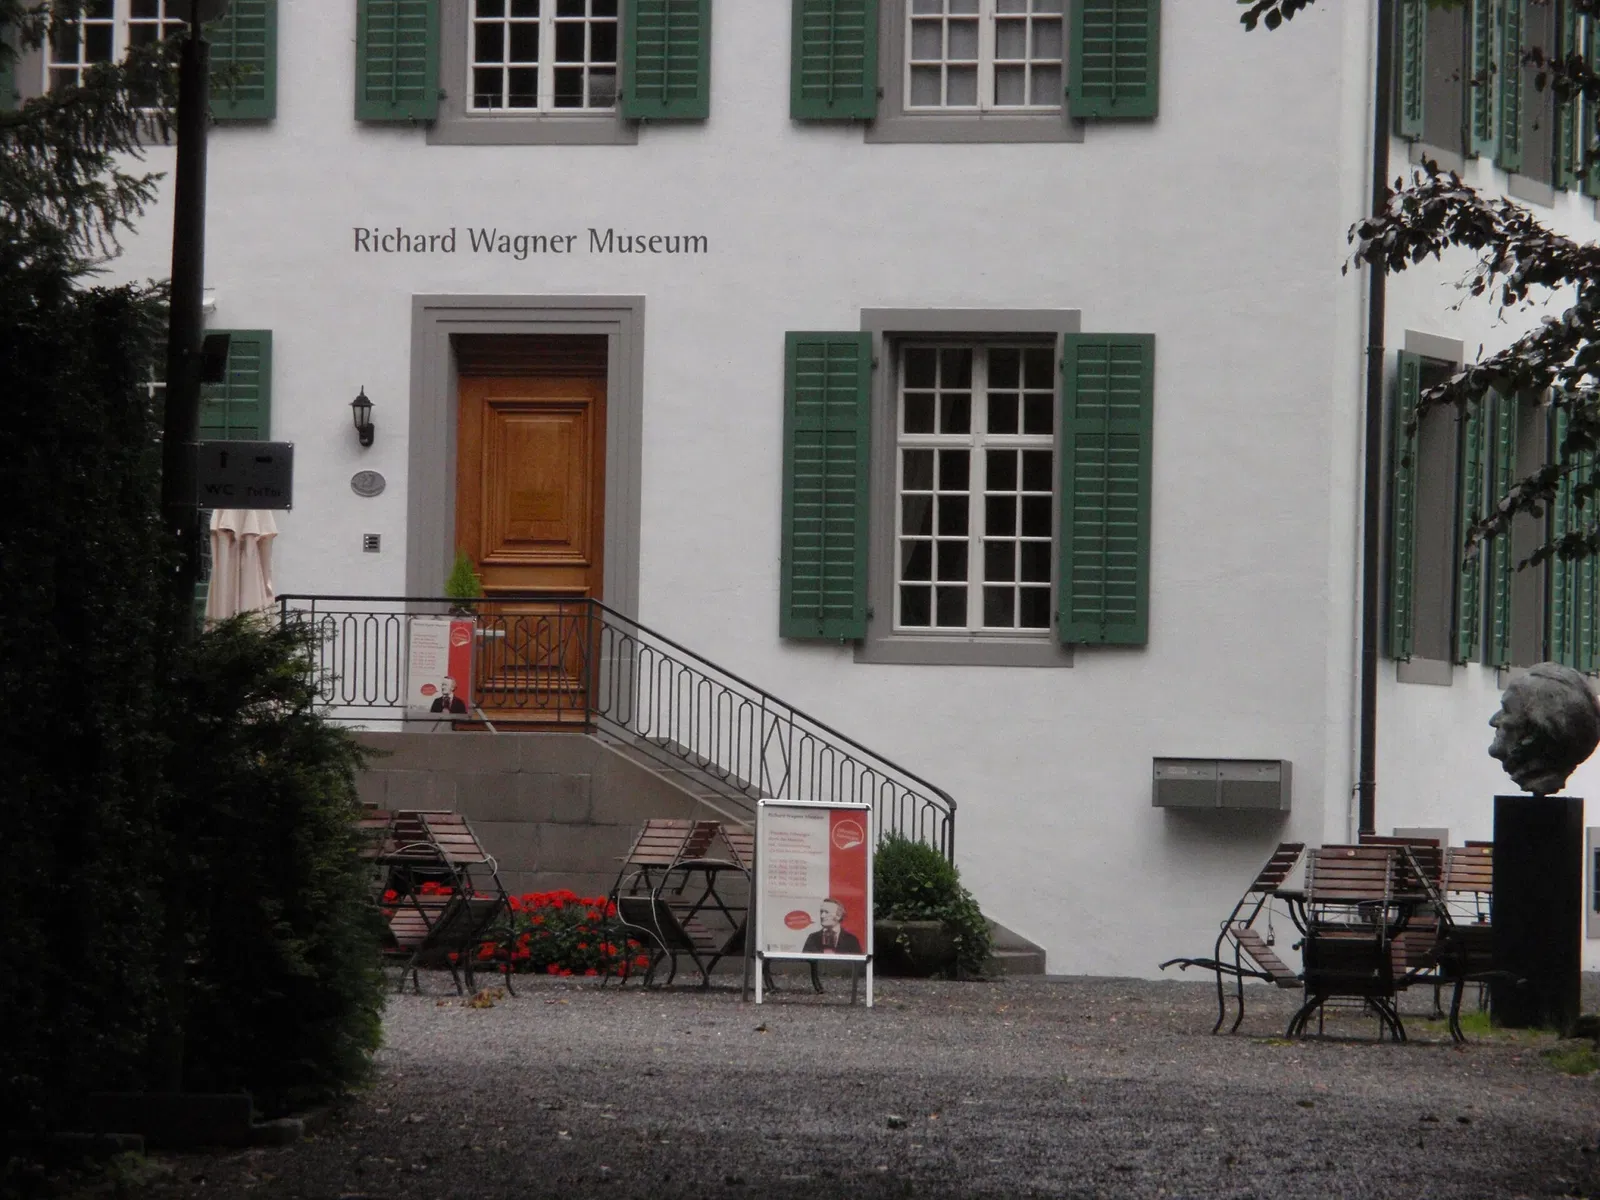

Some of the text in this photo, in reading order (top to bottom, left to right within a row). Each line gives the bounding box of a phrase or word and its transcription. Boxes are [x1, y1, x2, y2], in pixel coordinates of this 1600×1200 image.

[352, 227, 708, 260] Richard Wagner Museum
[203, 483, 235, 496] WC
